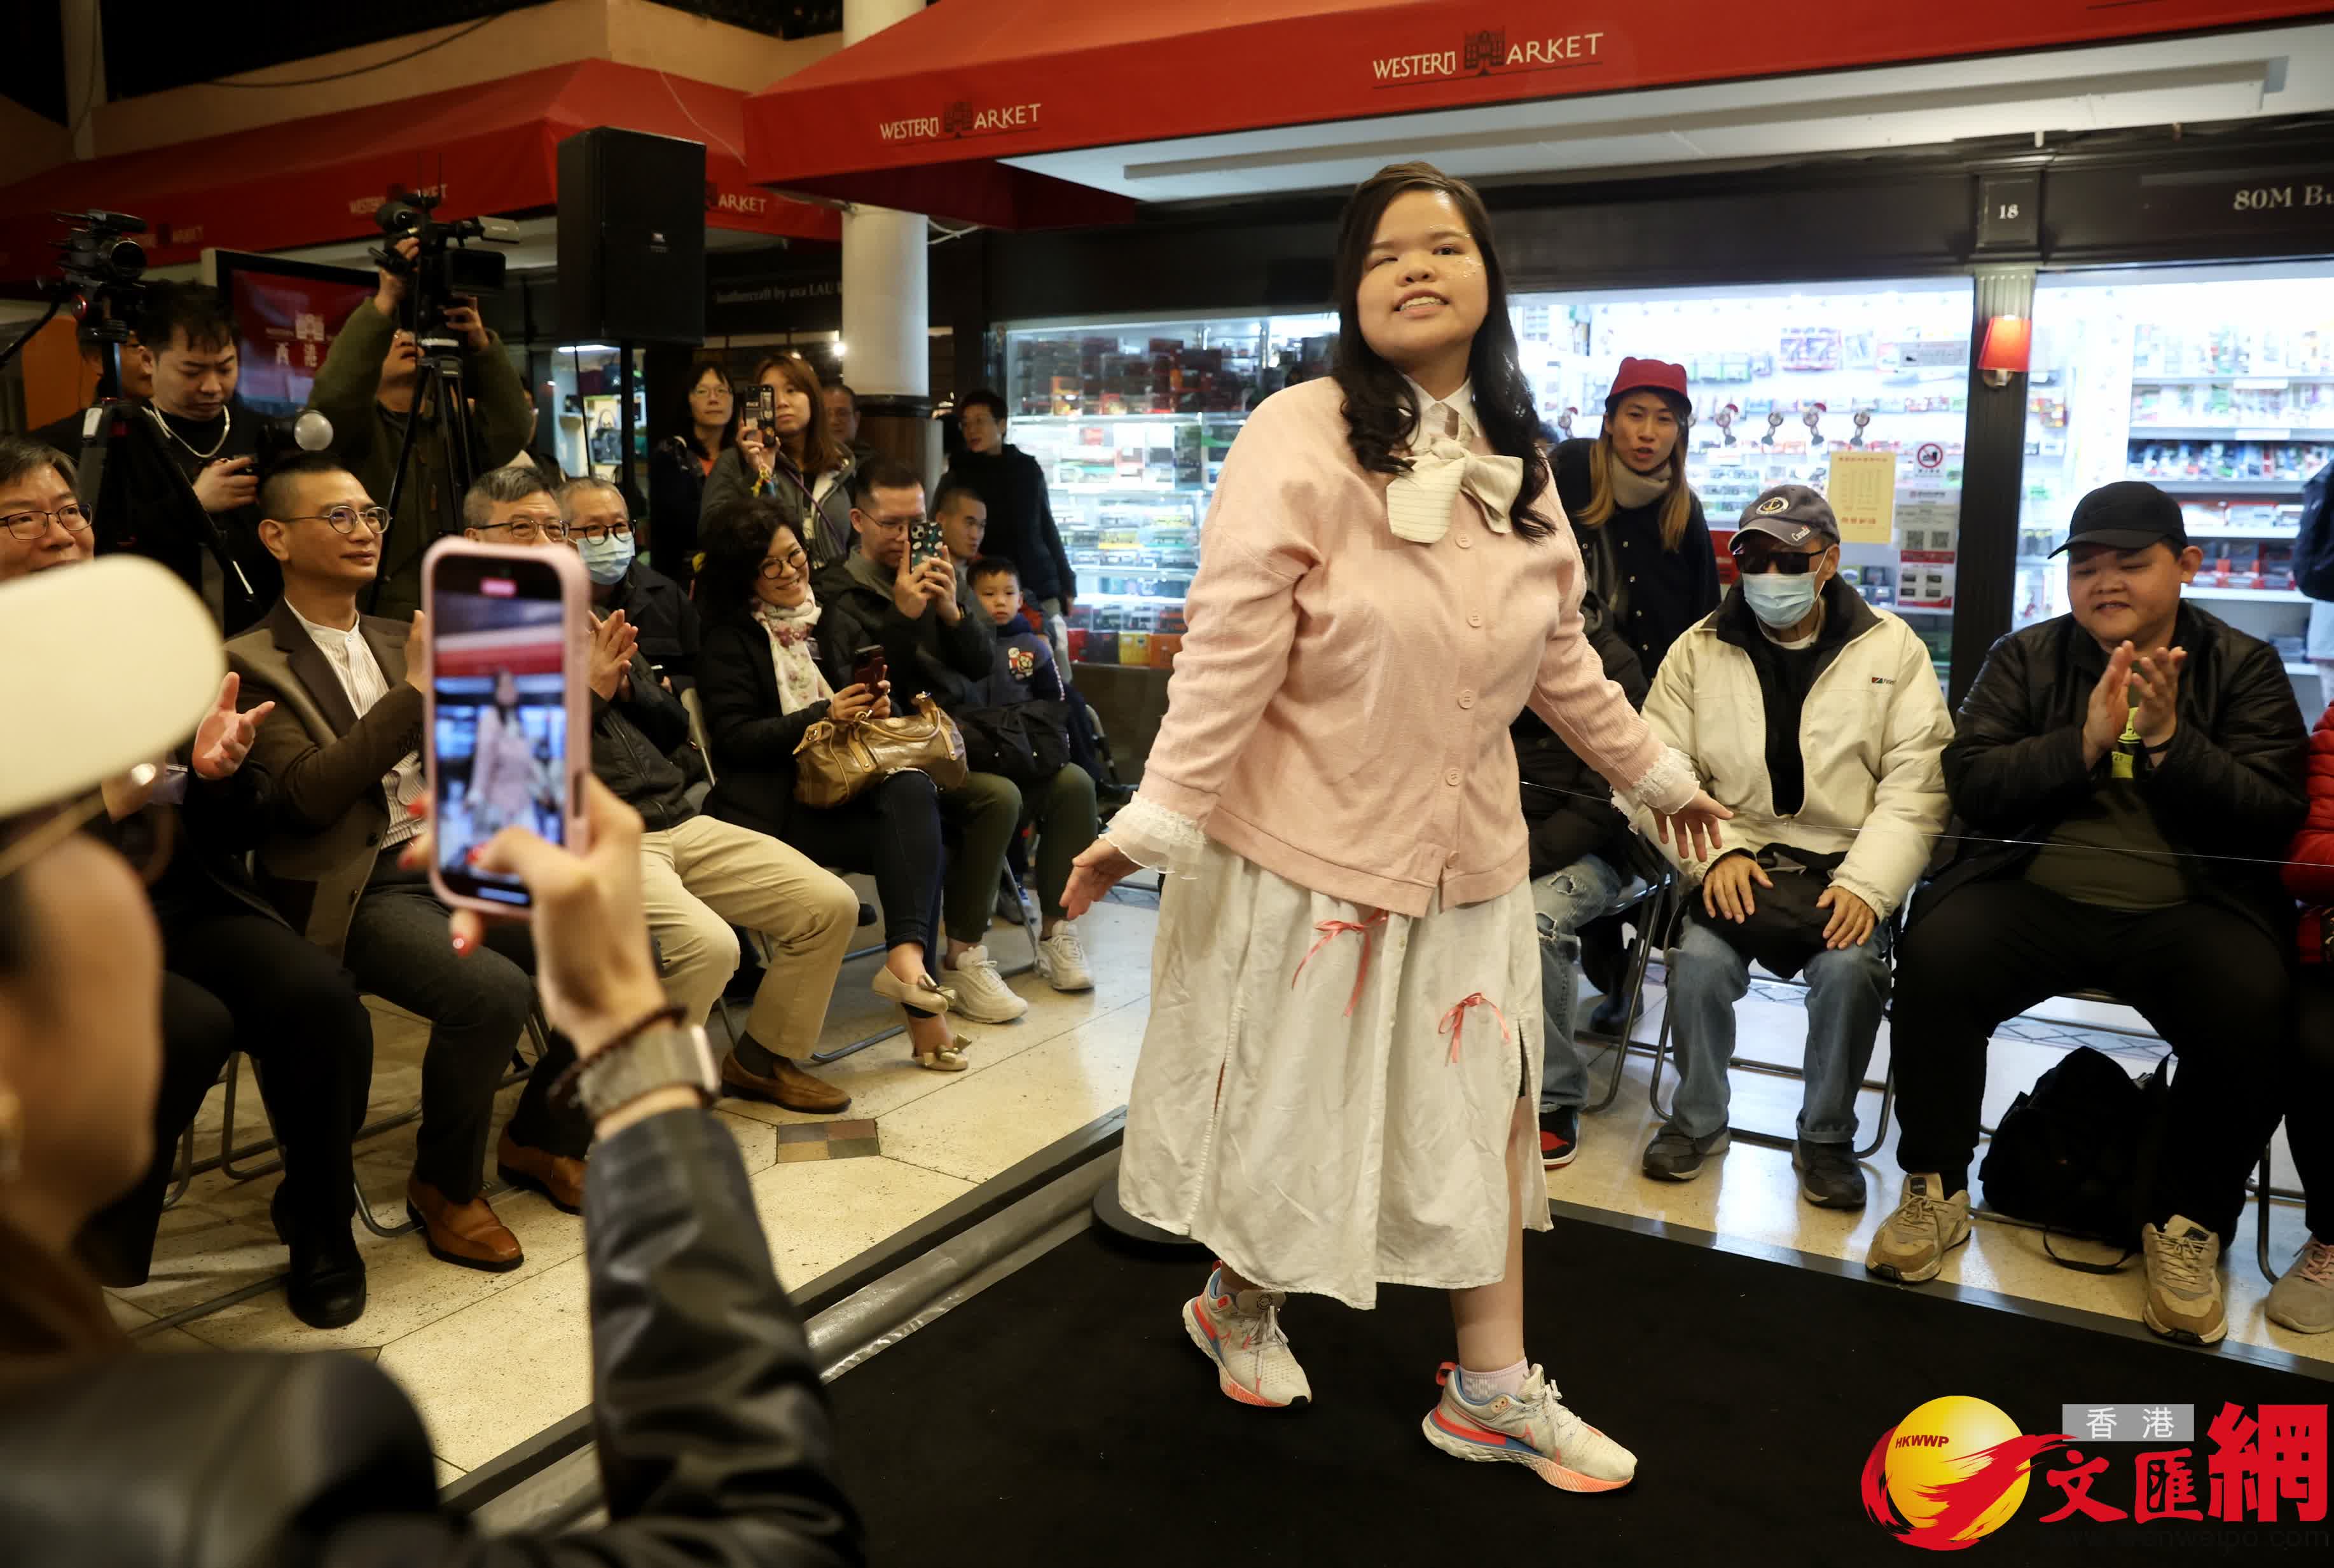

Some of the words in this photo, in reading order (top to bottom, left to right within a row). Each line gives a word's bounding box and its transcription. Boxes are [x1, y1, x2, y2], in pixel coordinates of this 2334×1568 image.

[1372, 50, 1456, 80] WESTERN
[880, 116, 939, 141] WESTERN
[1998, 203, 2019, 219] 18
[2233, 186, 2293, 211] 80M
